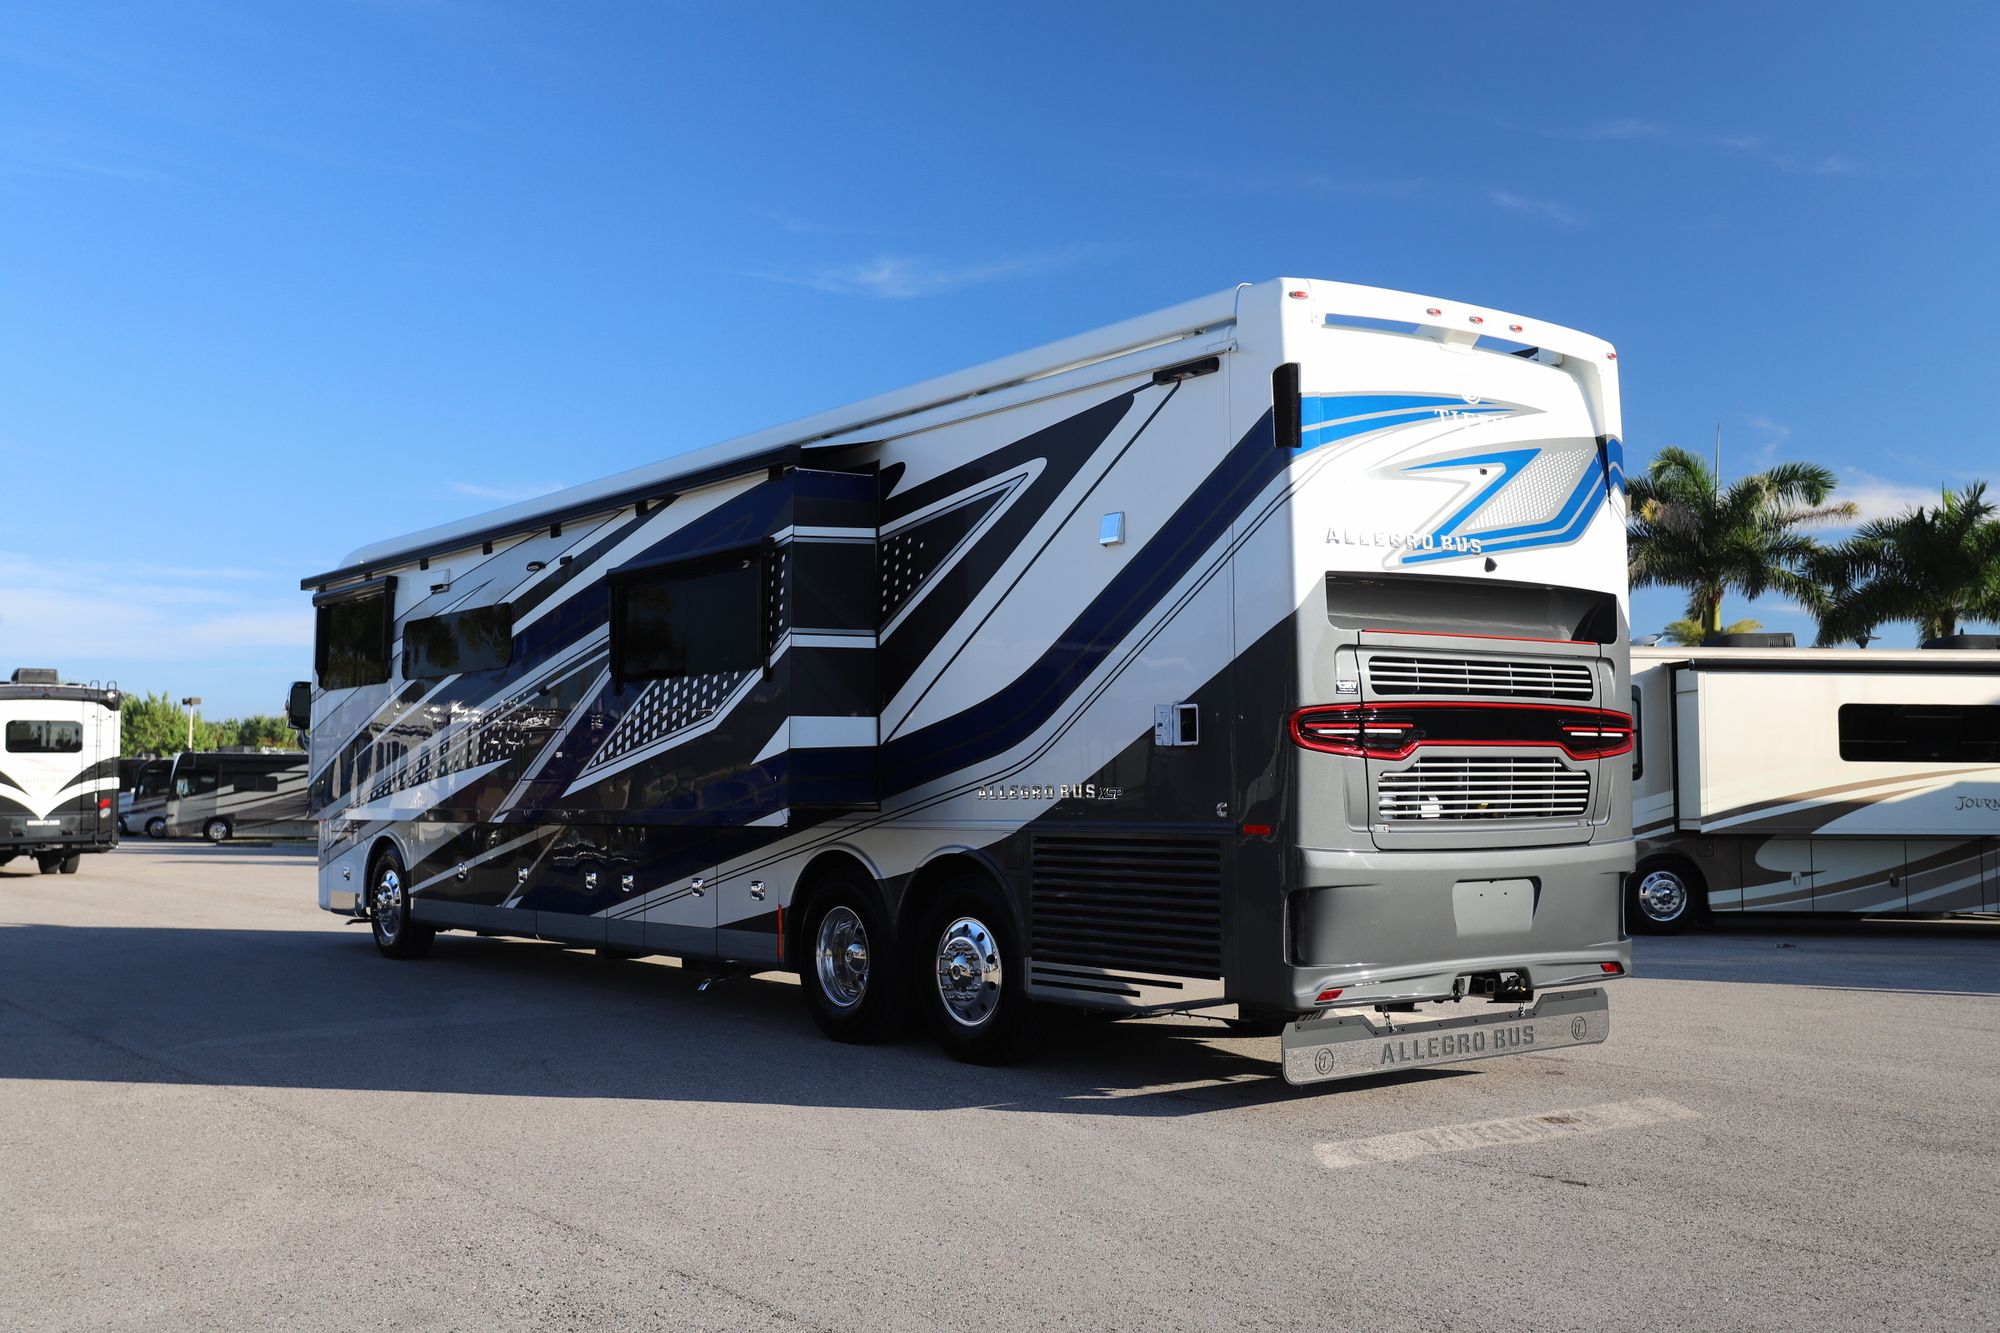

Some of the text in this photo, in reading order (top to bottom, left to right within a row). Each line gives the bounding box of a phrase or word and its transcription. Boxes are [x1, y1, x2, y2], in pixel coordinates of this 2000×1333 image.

[1325, 527, 1482, 555] ALLEGRO BUS
[978, 783, 1123, 800] ALLEGRO BUS XSP
[1381, 1025, 1534, 1065] ALLEGRO BUS
